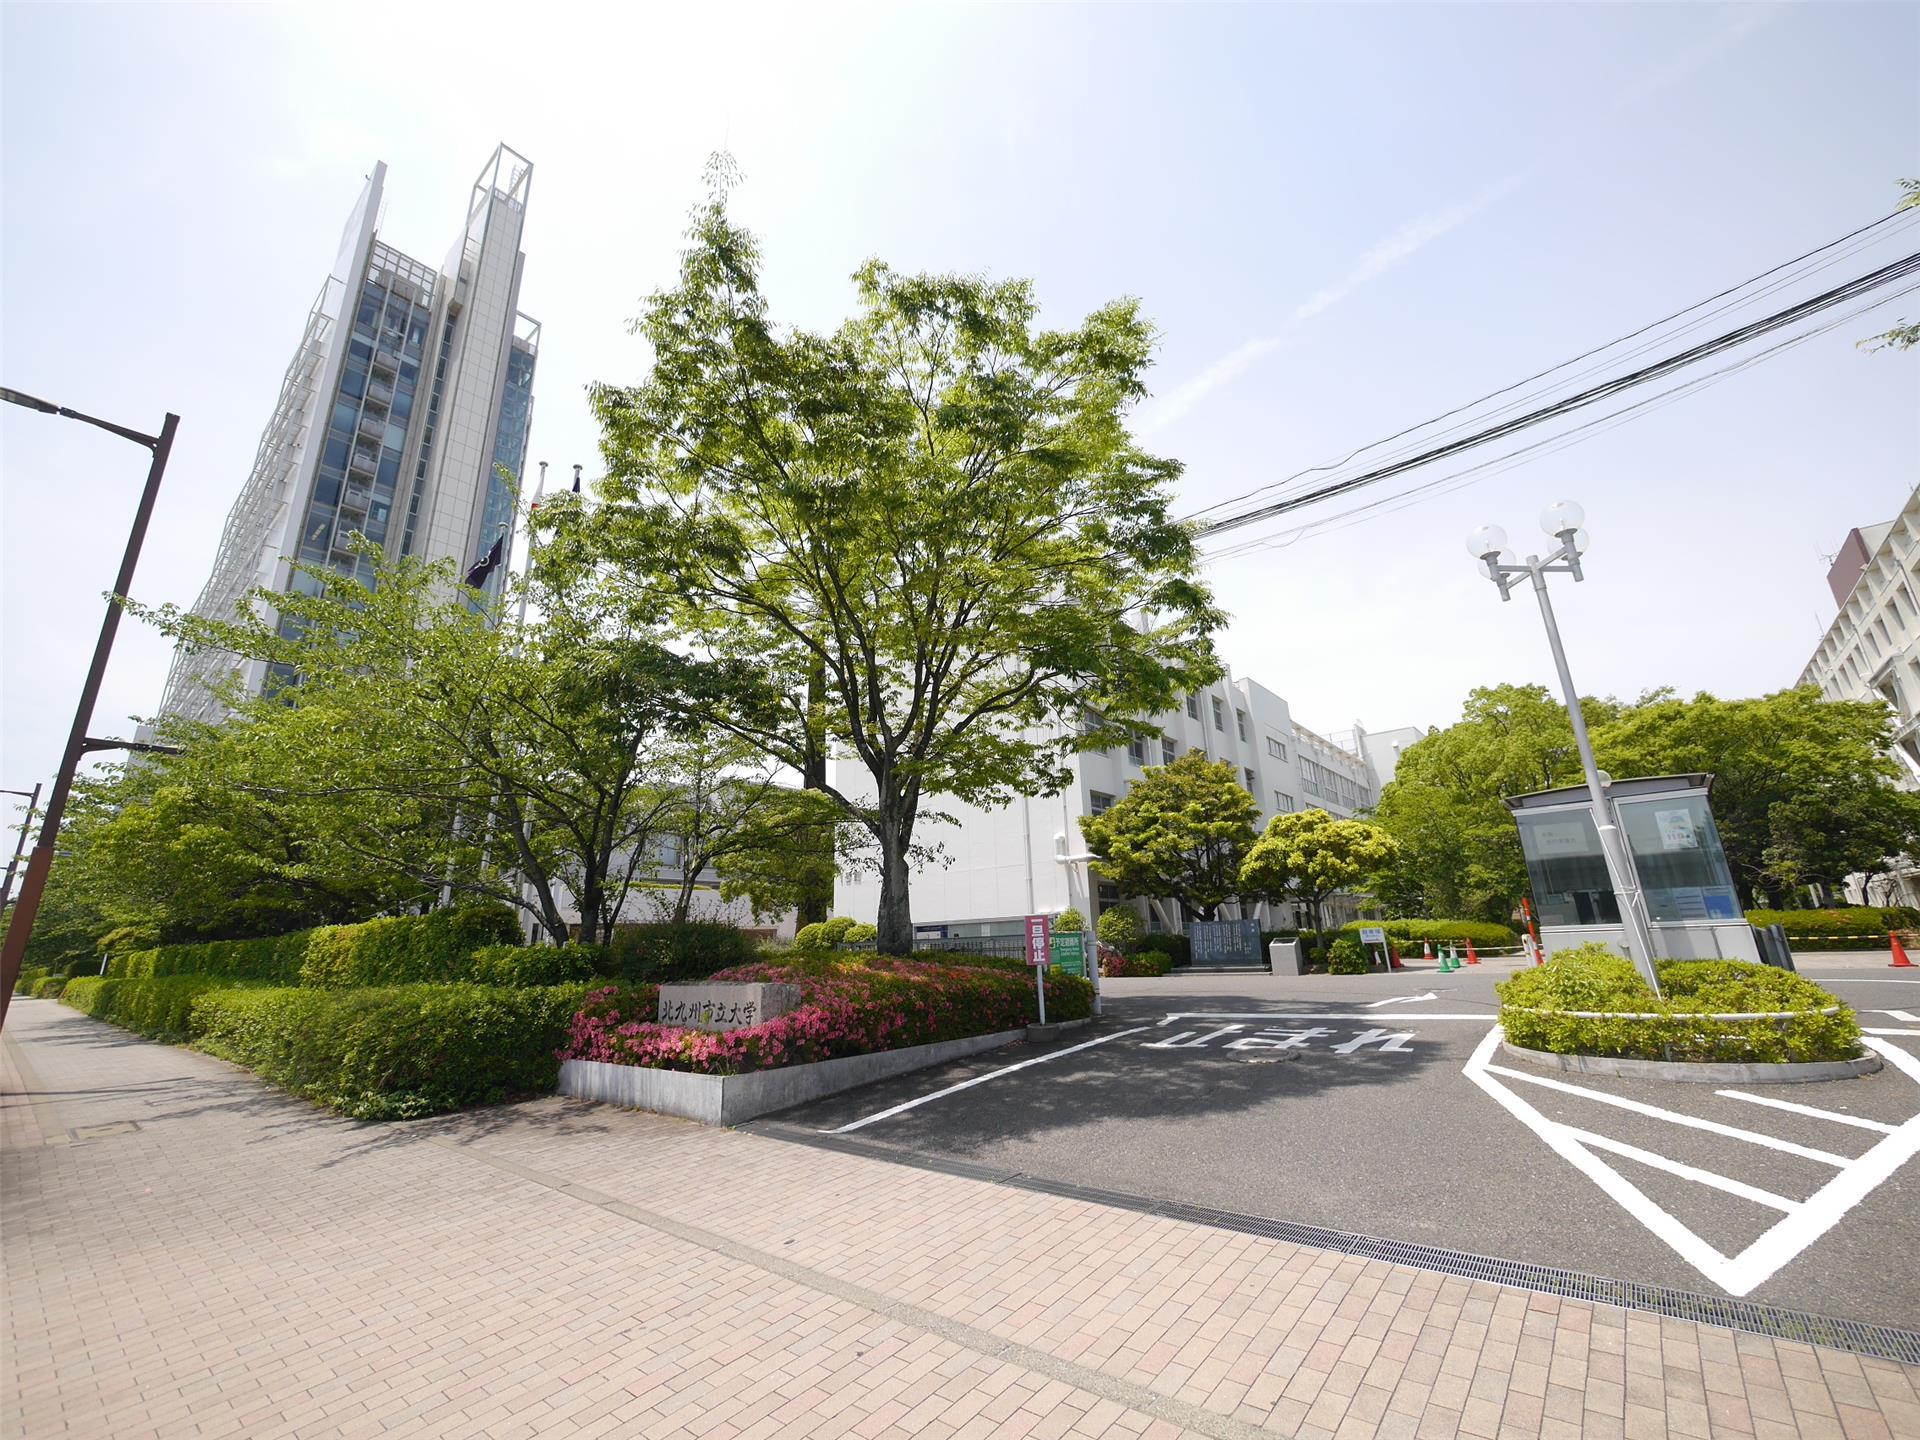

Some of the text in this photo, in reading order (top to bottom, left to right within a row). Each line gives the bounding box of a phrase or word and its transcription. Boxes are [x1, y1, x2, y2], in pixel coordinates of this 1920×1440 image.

[1031, 918, 1046, 962] 一旦停止
[662, 1000, 756, 1025] 北九州市立大学
[1139, 1023, 1417, 1054] 止まれ
